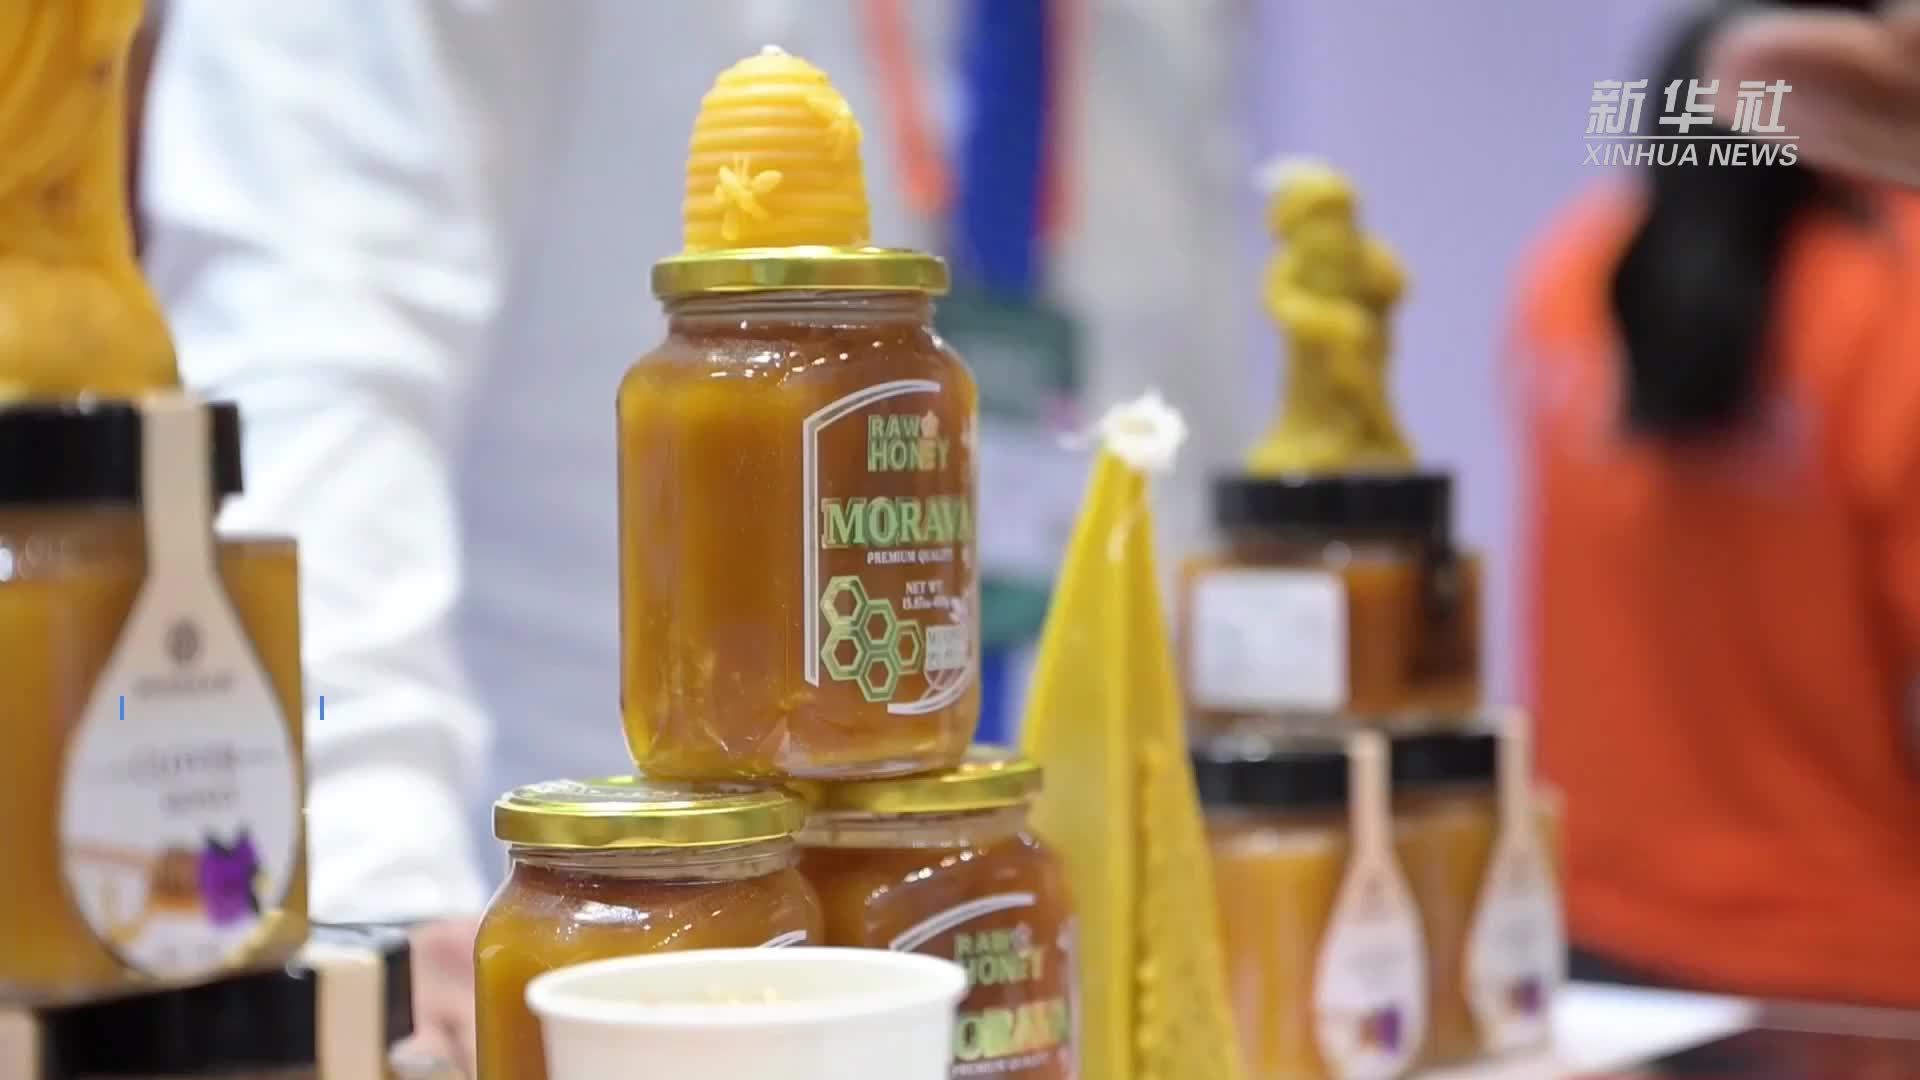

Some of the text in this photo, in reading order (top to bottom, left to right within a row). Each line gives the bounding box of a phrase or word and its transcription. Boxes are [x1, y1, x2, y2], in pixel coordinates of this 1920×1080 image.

[868, 415, 920, 438] RAW
[867, 437, 950, 472] HONEY
[867, 551, 916, 565] PREMIUM
